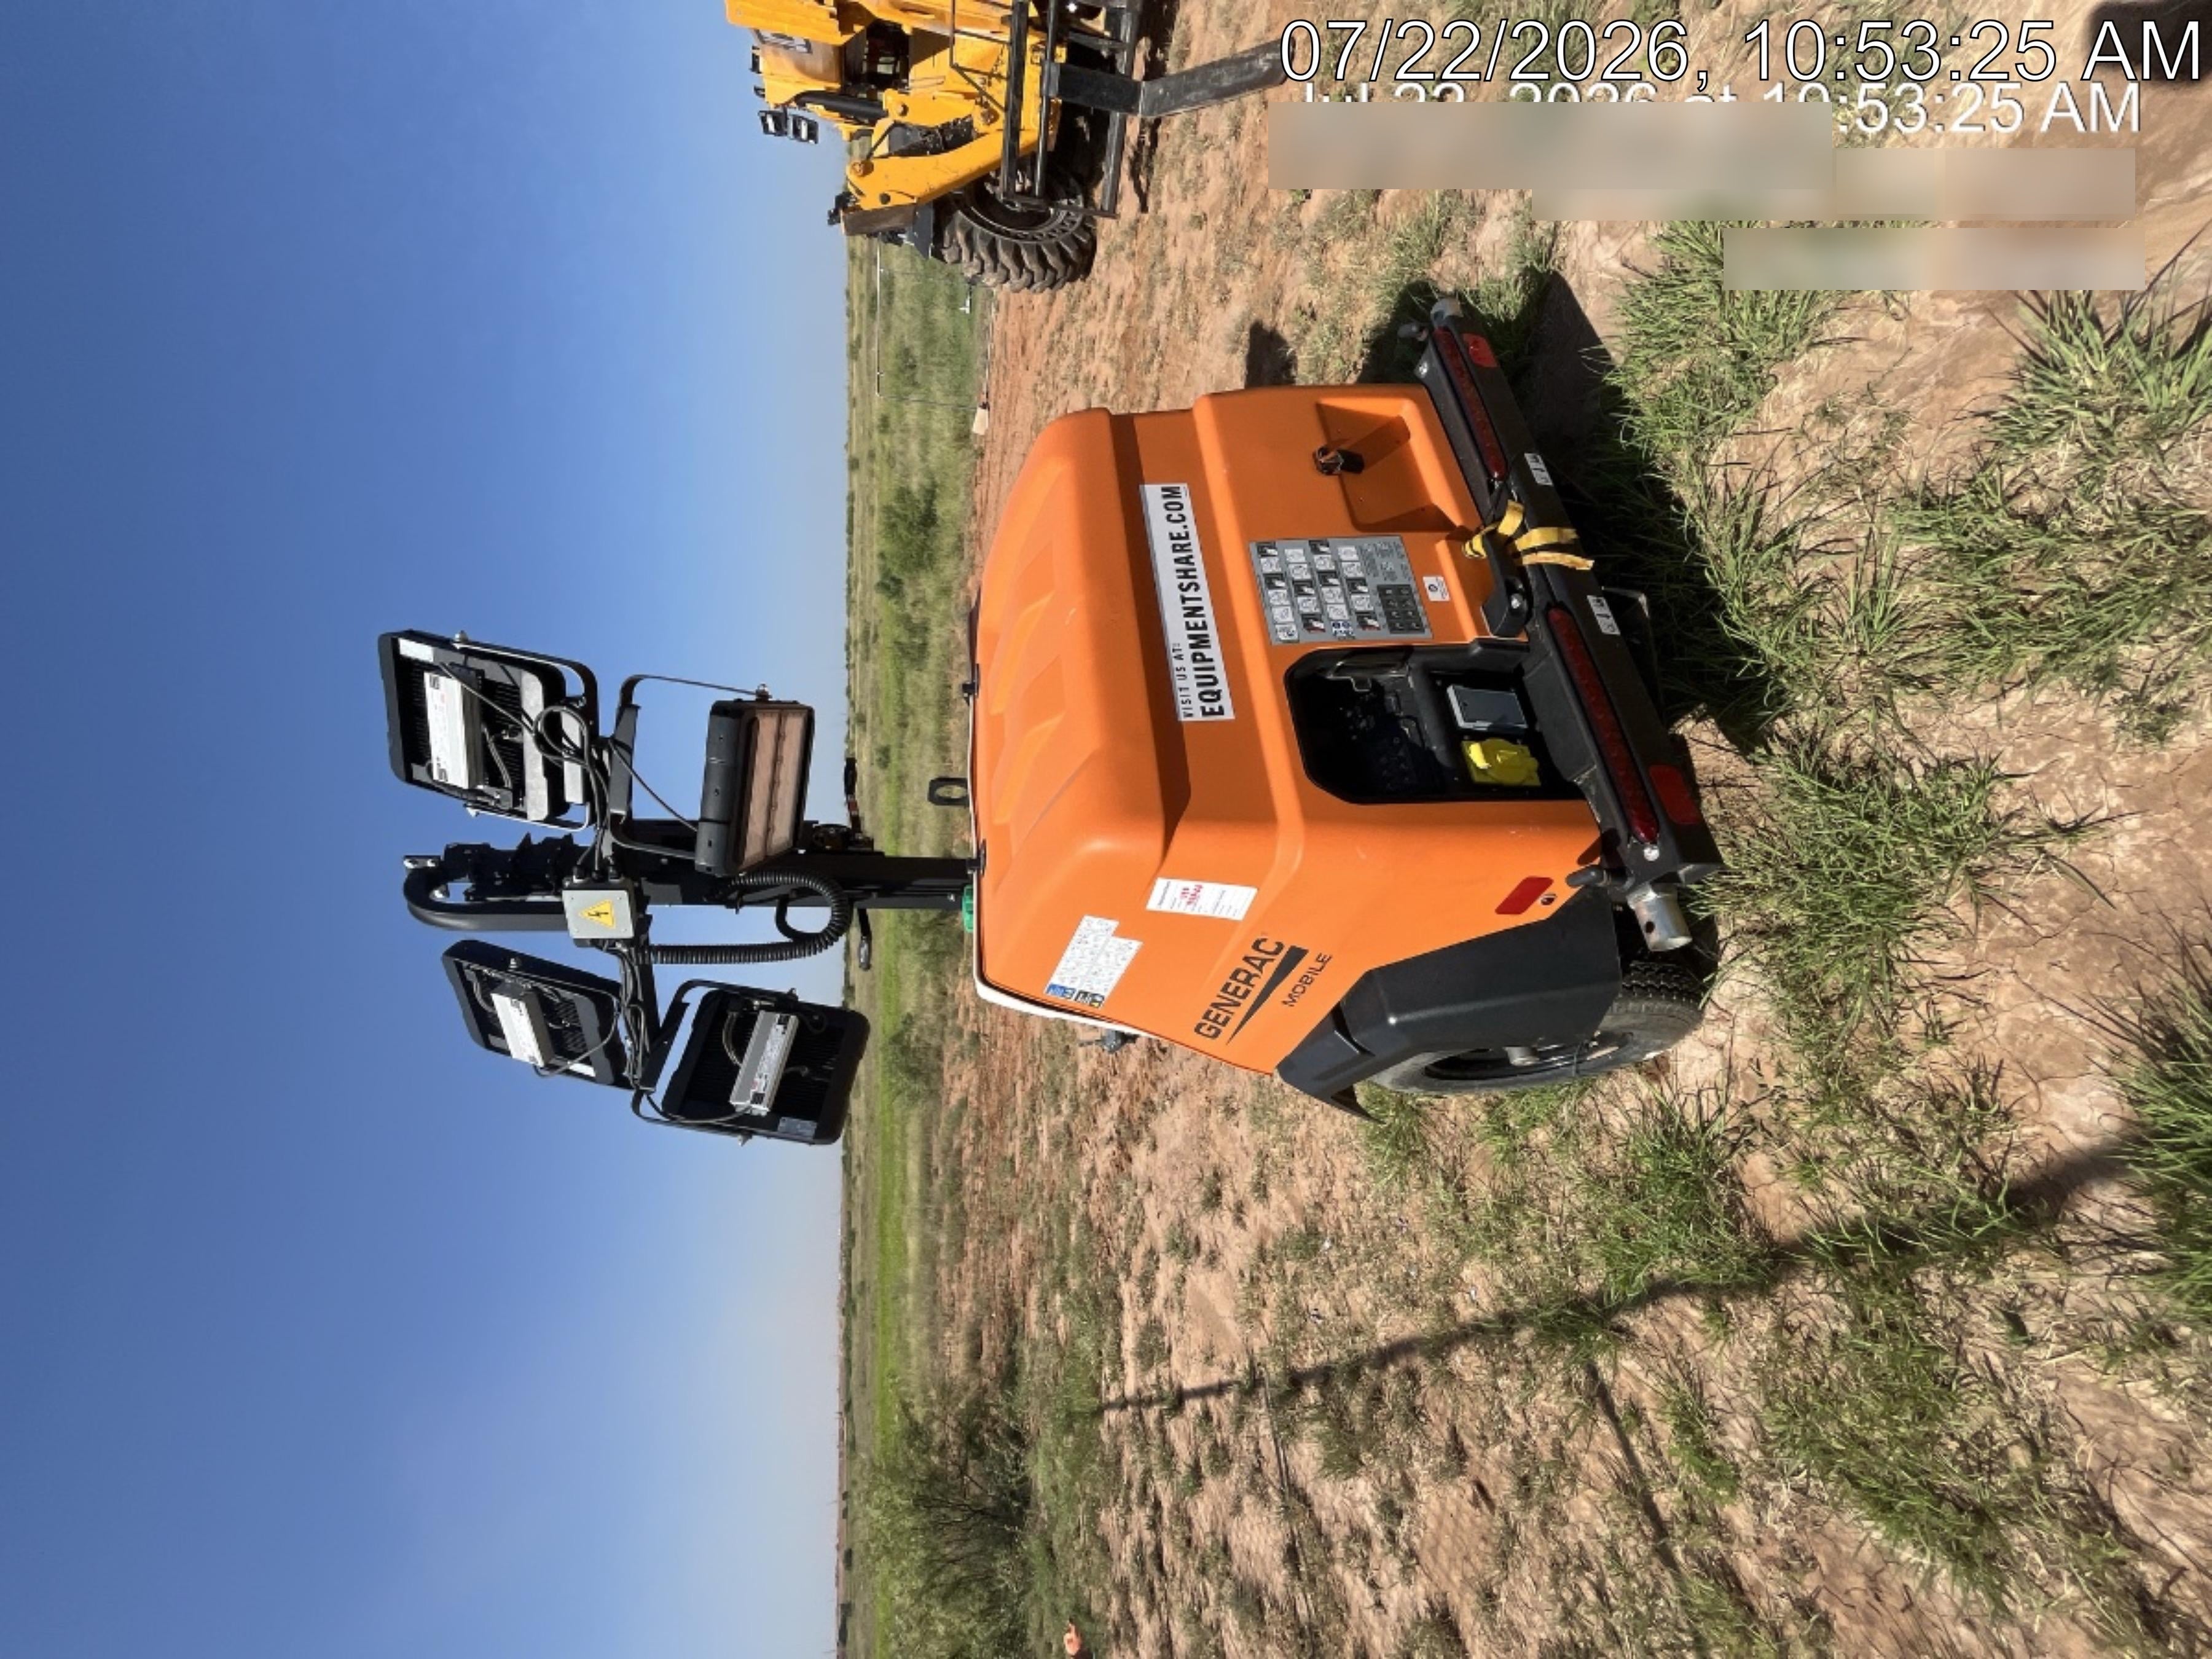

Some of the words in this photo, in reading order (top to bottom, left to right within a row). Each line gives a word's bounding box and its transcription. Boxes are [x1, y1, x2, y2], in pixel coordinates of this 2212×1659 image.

[1161, 486, 1225, 718] EQUIPMENTSHARE.COM
[1172, 643, 1185, 661] AT:
[1175, 666, 1188, 680] US
[1179, 686, 1194, 718] VISIT
[1194, 938, 1285, 1040] GENERAC
[1281, 953, 1333, 1007] MOBILE
